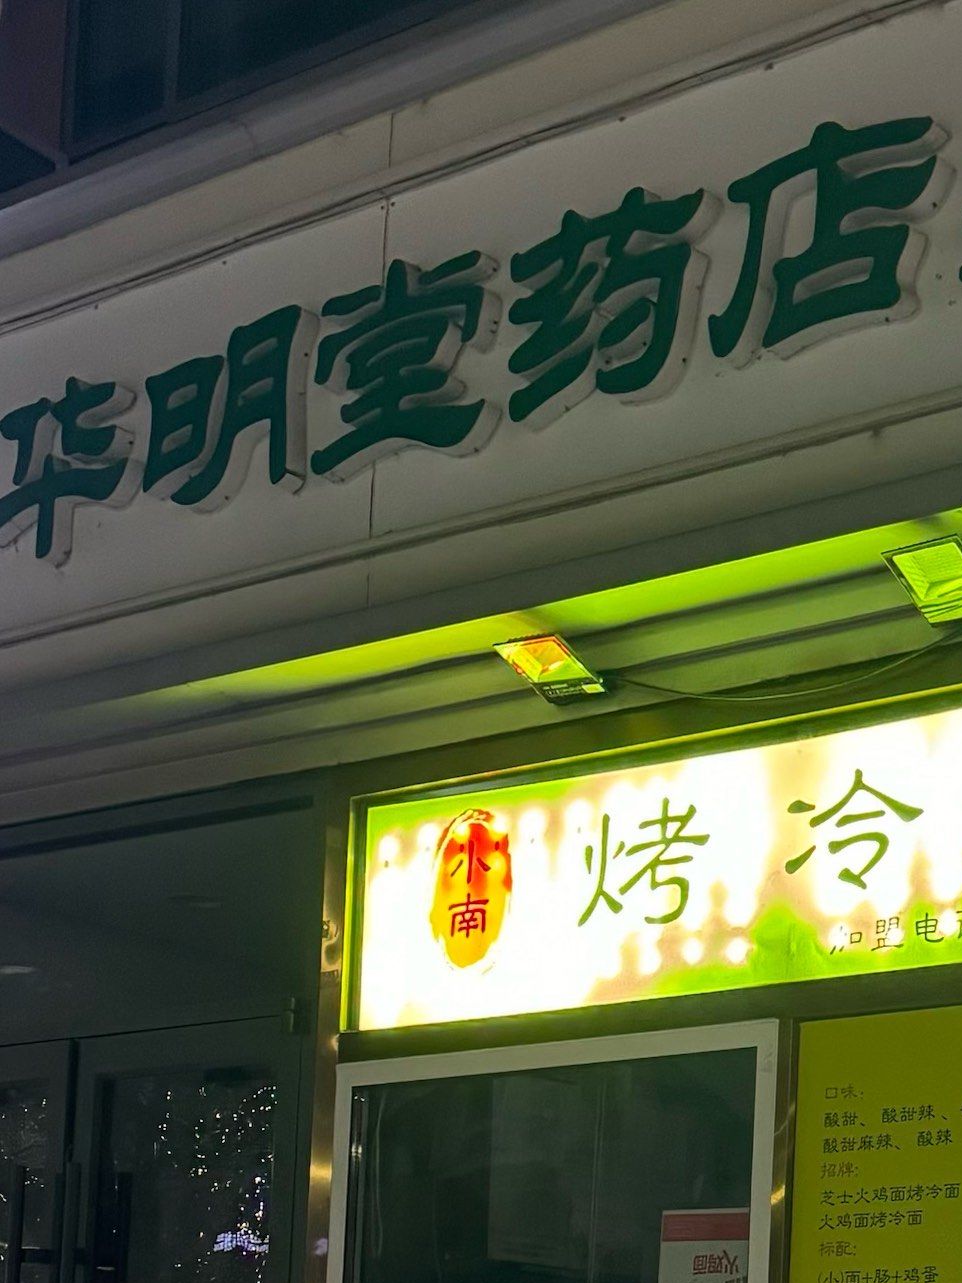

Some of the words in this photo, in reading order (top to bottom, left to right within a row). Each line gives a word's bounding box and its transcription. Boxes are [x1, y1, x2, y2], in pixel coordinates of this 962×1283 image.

[0, 119, 937, 560] 华明堂药店
[448, 840, 491, 938] 小南
[824, 1086, 864, 1101] 口味:
[820, 1163, 859, 1180] 招牌:
[820, 1183, 961, 1206] 芝士火鸡面烤冷面
[818, 1209, 923, 1231] 火鸡面烤冷面
